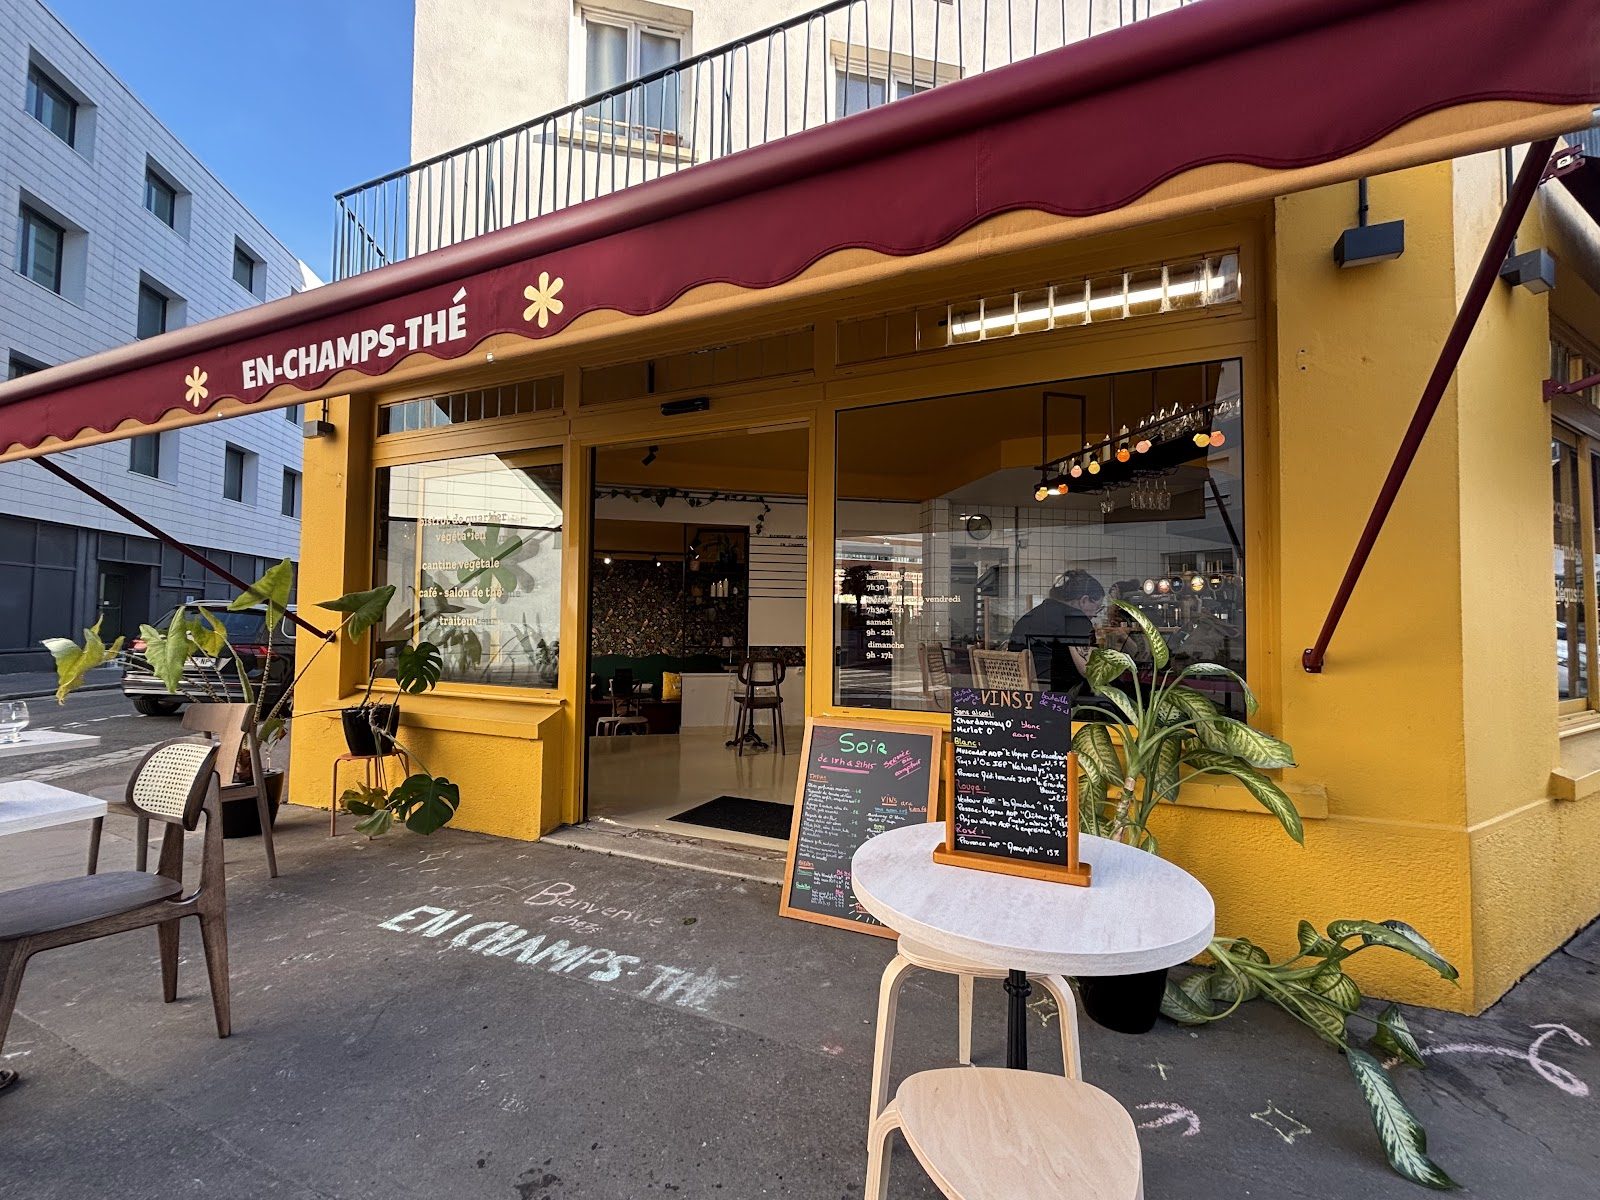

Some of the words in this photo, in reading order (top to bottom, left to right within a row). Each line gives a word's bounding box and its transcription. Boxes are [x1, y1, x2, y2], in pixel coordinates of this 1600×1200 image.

[242, 286, 467, 390] EN-CHAMPS-THÉ
[422, 560, 457, 570] cantine
[419, 586, 438, 598] café
[444, 586, 470, 598] salon
[472, 586, 483, 598] de
[925, 595, 961, 603] vendredi
[440, 615, 478, 626] traiteur
[866, 628, 876, 637] 9h
[867, 640, 905, 649] dimanche
[866, 651, 876, 660] 9h
[881, 652, 894, 660] 17h
[980, 690, 1022, 710] VINS
[954, 706, 970, 716] Sans
[956, 717, 1005, 731] Chardonnay
[956, 726, 984, 734] Merlot
[817, 753, 828, 763] de
[956, 779, 981, 795] Rouge
[956, 823, 978, 835] Rosé
[958, 837, 986, 847] Provence
[524, 881, 666, 927] Bienvenue
[376, 904, 473, 938] EN
